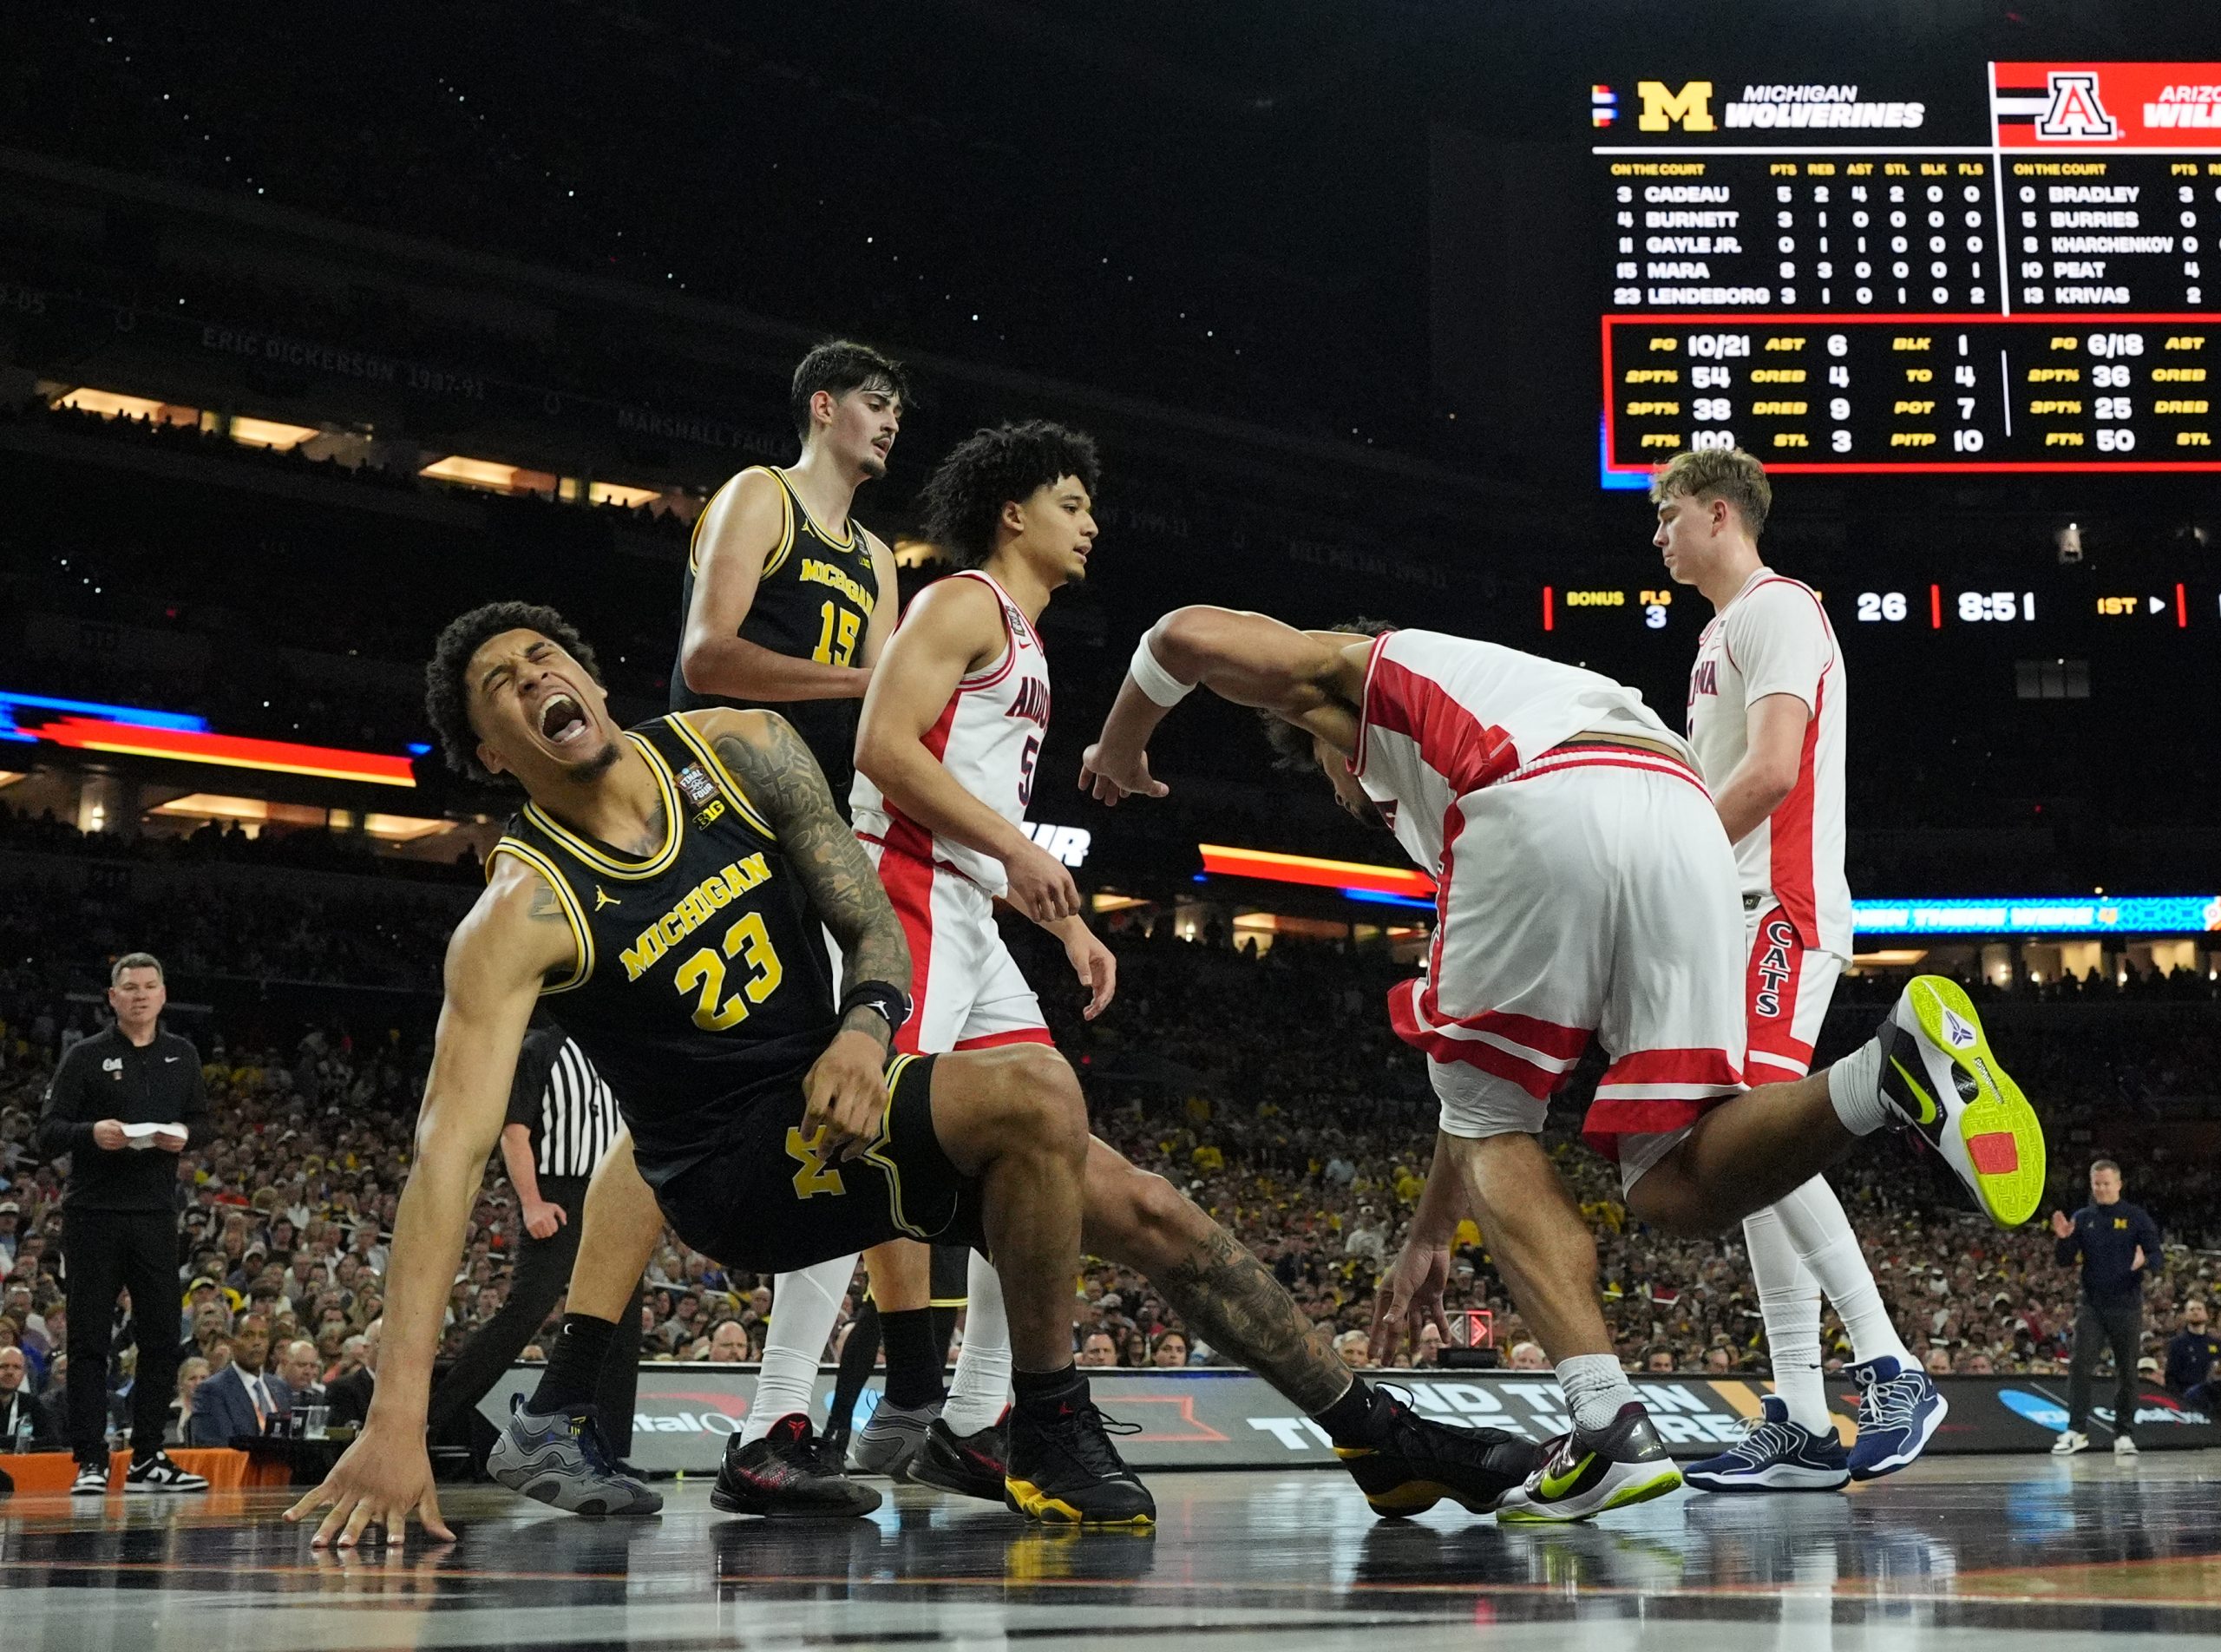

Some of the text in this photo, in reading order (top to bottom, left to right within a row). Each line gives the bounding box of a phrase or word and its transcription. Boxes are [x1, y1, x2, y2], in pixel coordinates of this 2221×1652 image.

[1743, 85, 1858, 102] MICHIGAN
[1638, 82, 1714, 131] M
[1724, 102, 1925, 128] WOLVERINES
[1611, 163, 1983, 175] ON THE COURT PTS REB AST STL BLK FLS
[2014, 164, 2034, 175] ON
[2034, 164, 2060, 175] THE
[2061, 163, 2106, 175] COURT
[2172, 164, 2198, 175] PTS
[1617, 186, 1980, 202] 3 CADEAU 5 2 4 2 0 0
[2020, 187, 2193, 203] 0 BRADLEY 3
[1617, 211, 1981, 228] 4 BURNETT 3 1 0 0 0 0
[2022, 211, 2196, 228] 5 BURRIES 0
[1646, 237, 1711, 253] GAYLE
[1713, 237, 1742, 253] JR.
[1779, 237, 1794, 252] 0
[1820, 237, 1827, 252] 1
[1858, 237, 1865, 252] 1
[1891, 236, 1908, 252] 0
[1929, 236, 1945, 252] 0
[1967, 236, 1982, 252] 0
[2023, 237, 2038, 252] 8
[2052, 236, 2173, 252] KHARCHENKOV
[2182, 236, 2198, 252] 0
[1616, 262, 1980, 279] 15 MARA 8 3 0 0 0 1
[2021, 262, 2199, 279] 10 PEAT 4
[1614, 287, 1985, 305] 23 LENDEBORG 3 1 0 1 0 2
[2024, 287, 2201, 304] 13 KRIVAS 2
[202, 326, 258, 355] ERIC
[265, 339, 394, 382] DICKERSON
[1649, 334, 1968, 359] FG 10/21 AST 6 BLK 1
[2051, 333, 2205, 358] FG 6/18 AST
[1692, 367, 1731, 389] 54
[1751, 370, 1806, 383] OREB
[1829, 366, 1850, 388] 4
[1906, 370, 1932, 382] TO
[1956, 366, 1975, 387] 4
[2093, 365, 2130, 387] 36
[2152, 369, 2206, 382] OREB
[1693, 398, 1731, 421] 38
[1753, 402, 1807, 415] DREB
[1830, 398, 1850, 420] 9
[1894, 401, 1935, 414] POT
[1957, 397, 1975, 419] 7
[2095, 397, 2132, 419] 25
[2154, 401, 2209, 413] DREB
[617, 409, 725, 448] MARSHALL
[1692, 430, 1735, 452] 100
[1774, 434, 1808, 447] STL
[1832, 430, 1851, 452] 3
[1891, 434, 1936, 446] PITP
[1954, 429, 1983, 451] 10
[2096, 429, 2135, 451] 50
[2177, 433, 2211, 445] STL
[1567, 591, 1671, 606] BONUS FLS
[1857, 593, 1907, 621] 26
[1958, 592, 2034, 621] 8:51
[2097, 597, 2137, 614] 1ST
[1645, 606, 1667, 628] 3
[812, 600, 861, 667] 15
[679, 769, 704, 789] FINAL
[1018, 734, 1039, 807] 5
[691, 783, 714, 801] FOUR
[619, 852, 772, 982] MICHIGAN
[674, 912, 783, 1031] 23
[1755, 921, 1793, 1018] CATS
